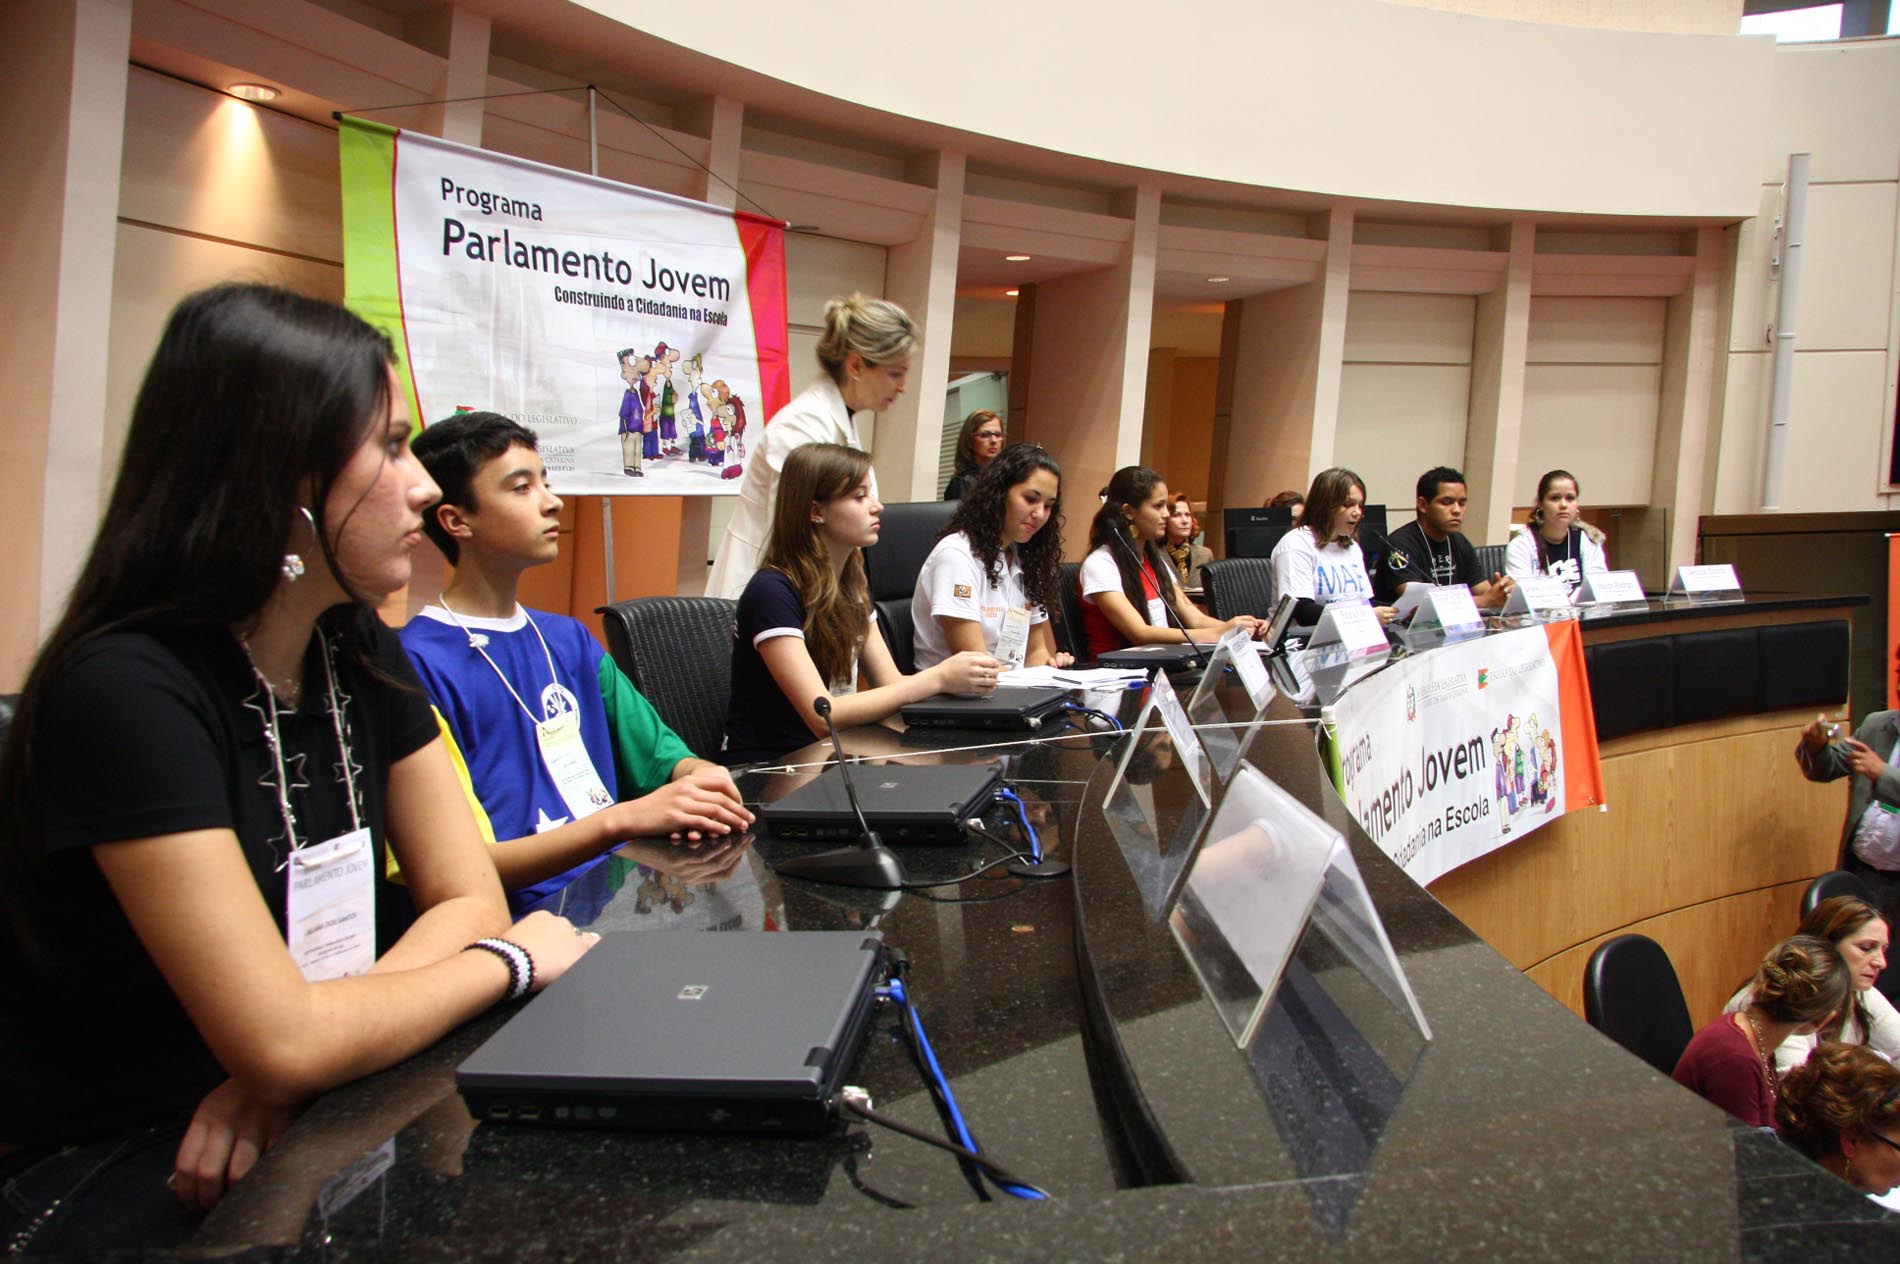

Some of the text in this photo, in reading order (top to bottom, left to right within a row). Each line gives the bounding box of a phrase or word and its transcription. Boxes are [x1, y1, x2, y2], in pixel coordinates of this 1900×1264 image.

[441, 177, 543, 221] Programa
[443, 218, 730, 301] Parlamento Jovem
[554, 286, 728, 327] Construindo a Cidadania na Escola
[527, 414, 578, 425] LEGISLATIVO
[536, 446, 575, 455] GISLATIVA
[1342, 733, 1372, 790] rograma
[1358, 736, 1486, 842] lamento Jovem
[1428, 817, 1442, 843] na
[1446, 794, 1490, 832] Escola
